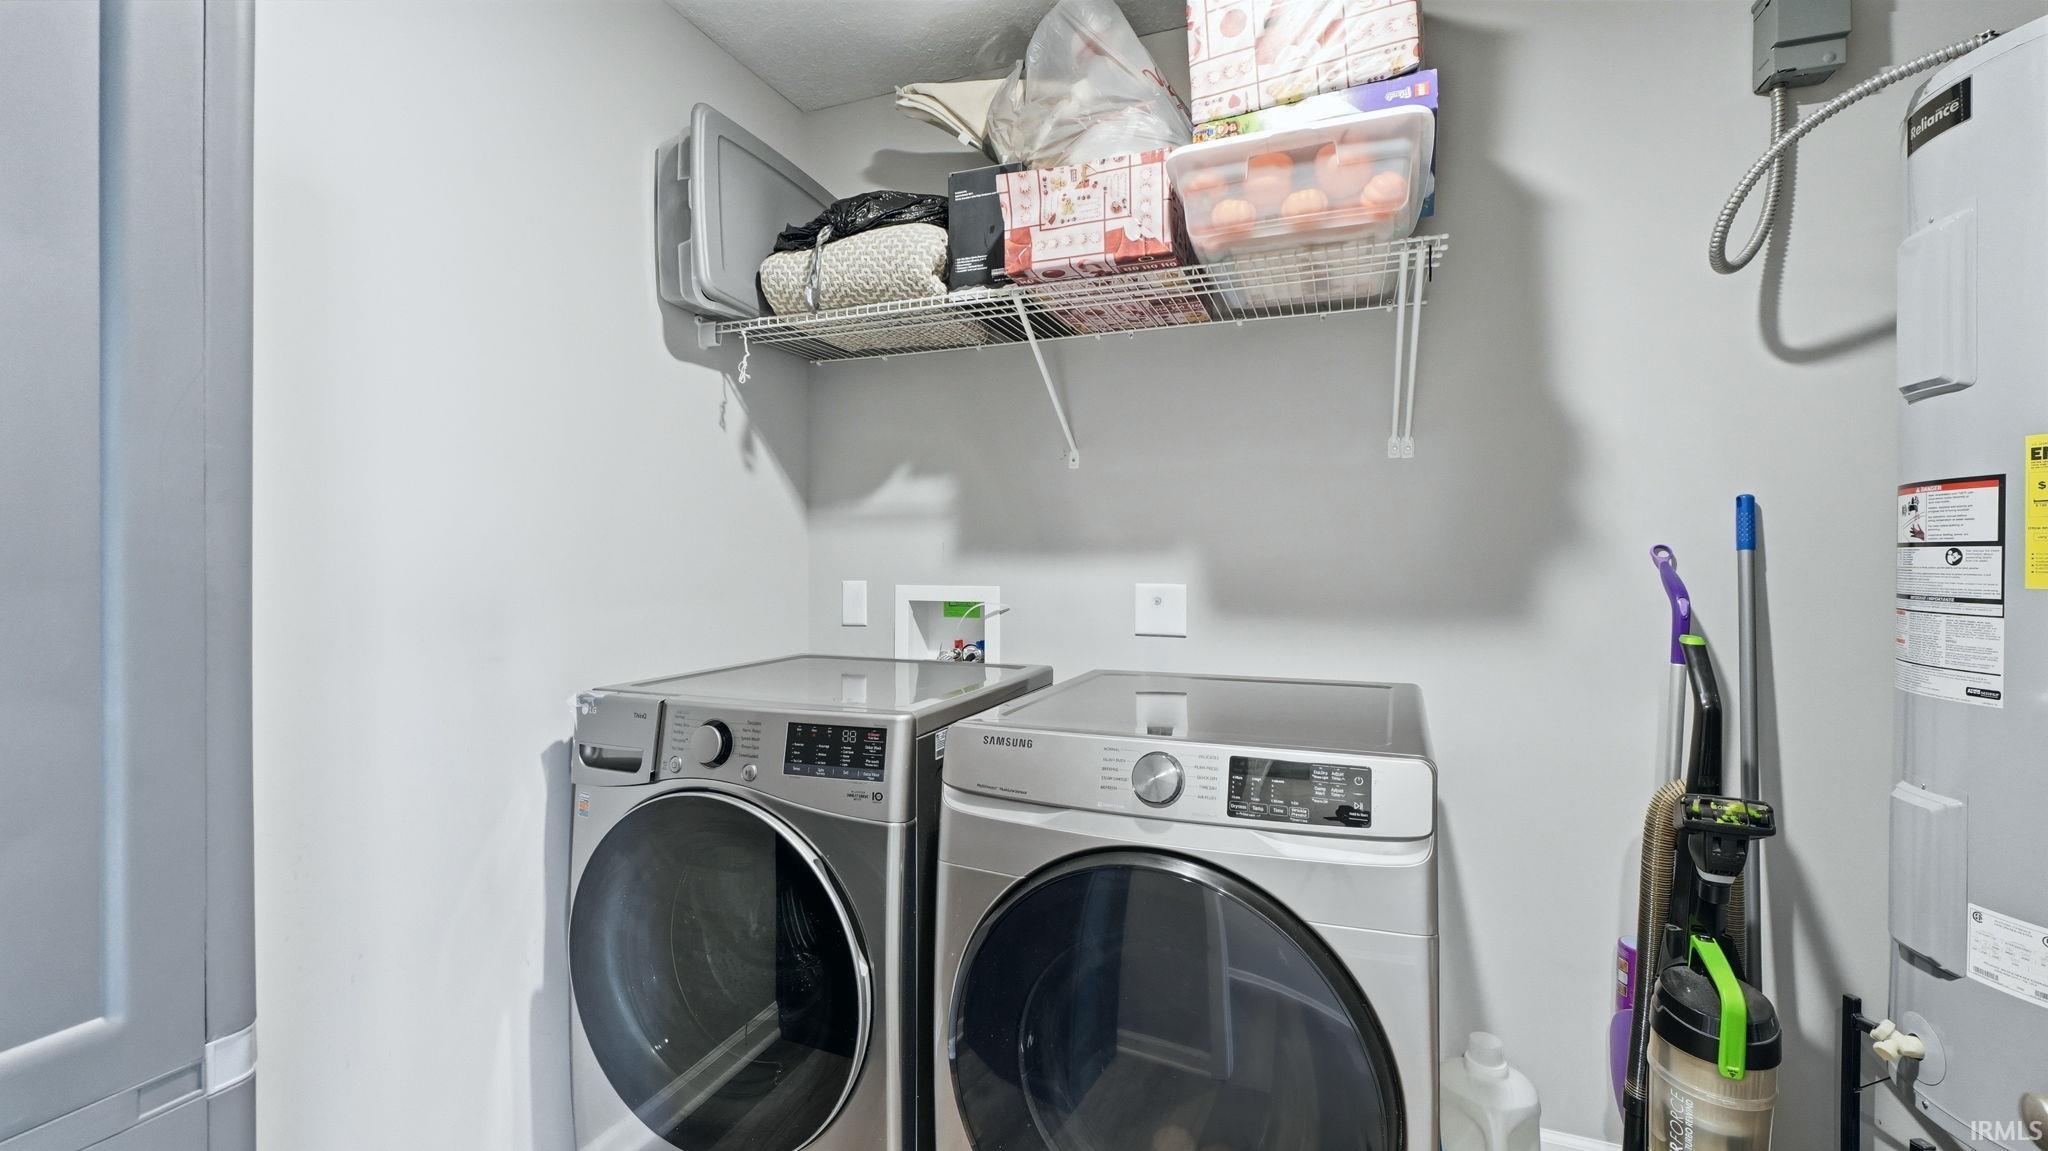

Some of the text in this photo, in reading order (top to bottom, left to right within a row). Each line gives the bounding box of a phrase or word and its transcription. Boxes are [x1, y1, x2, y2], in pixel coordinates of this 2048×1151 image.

[1910, 100, 1960, 141] Reliance
[2030, 446, 2048, 461] E
[1920, 484, 1942, 493] DANGER
[633, 712, 647, 720] ThinQ
[983, 735, 1033, 749] SAMSUNG
[1669, 1088, 1684, 1151] RFORCE
[1685, 1098, 1694, 1127] REWIND
